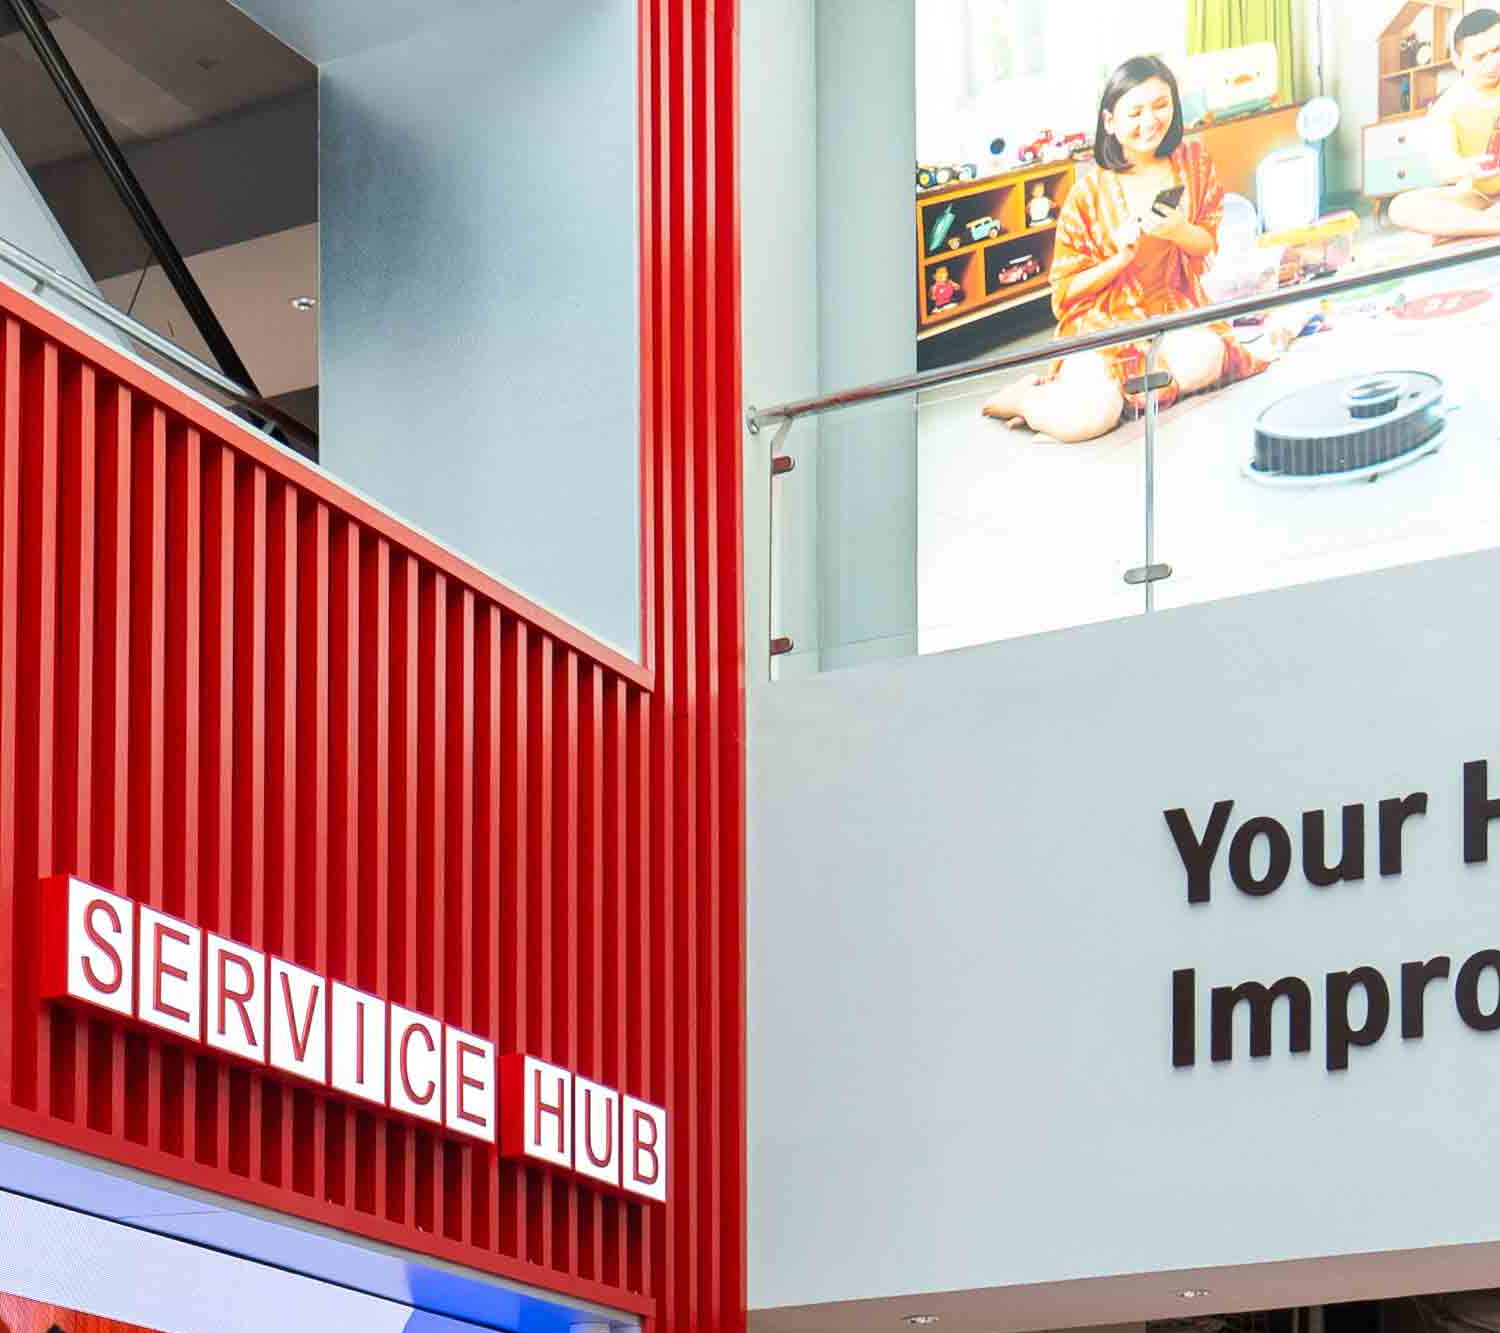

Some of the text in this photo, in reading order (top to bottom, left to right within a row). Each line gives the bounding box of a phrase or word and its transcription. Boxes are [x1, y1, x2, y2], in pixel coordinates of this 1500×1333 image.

[1164, 792, 1428, 905] Your
[80, 897, 661, 1188] SERVICE HUB
